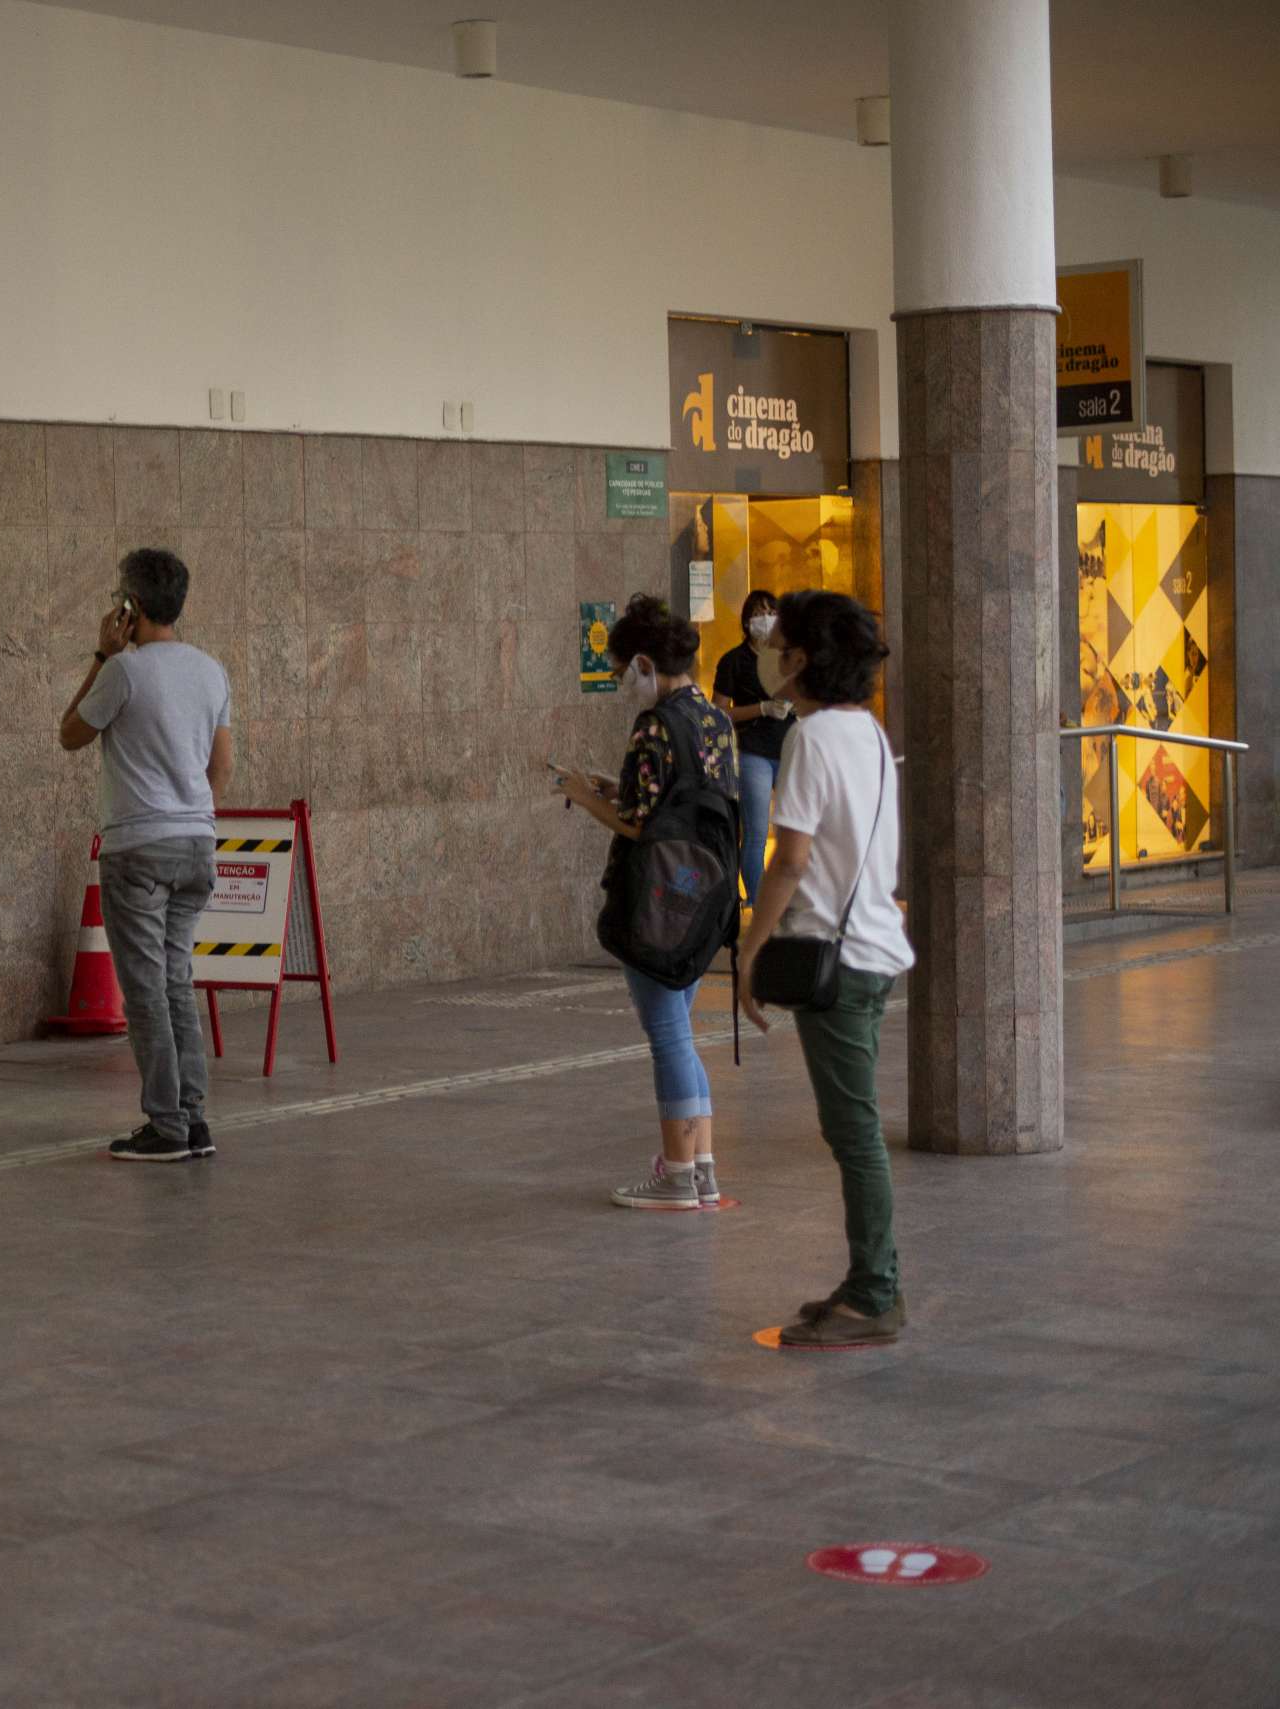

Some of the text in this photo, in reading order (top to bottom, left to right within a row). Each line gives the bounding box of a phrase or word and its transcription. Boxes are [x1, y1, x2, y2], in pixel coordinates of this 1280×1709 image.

[1057, 344, 1106, 358] inema
[1066, 354, 1119, 373] dragão
[727, 385, 798, 421] cinema
[1078, 389, 1121, 417] sala 2
[728, 420, 814, 459] do dragão
[1125, 441, 1176, 477] dragão
[1186, 570, 1193, 593] 2
[216, 865, 256, 877] TENÇÃO
[213, 892, 261, 902] MANUTENÇÃO
[229, 883, 240, 891] EM
